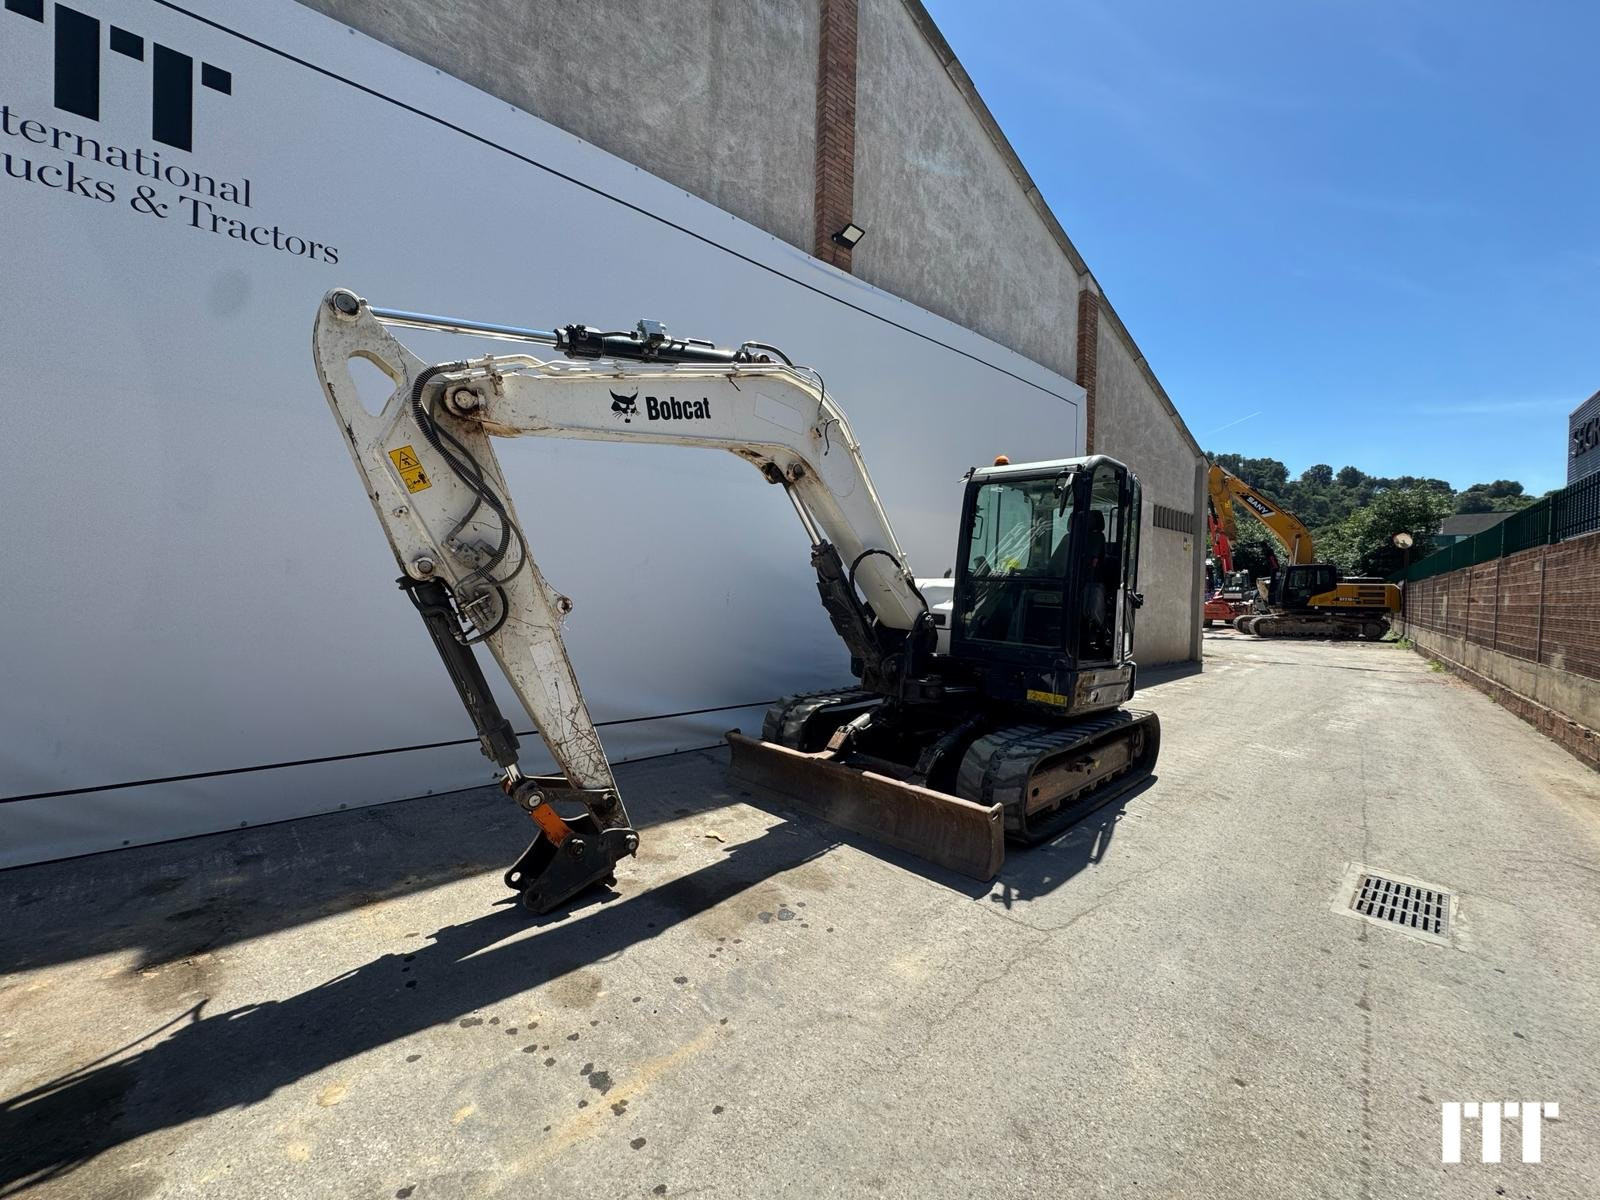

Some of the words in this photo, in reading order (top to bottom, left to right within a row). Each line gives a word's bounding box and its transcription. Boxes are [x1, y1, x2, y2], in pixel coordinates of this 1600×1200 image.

[130, 185, 169, 219] &
[179, 195, 339, 265] Tractors
[645, 396, 711, 420] Bobcat
[1246, 496, 1269, 514] SANY
